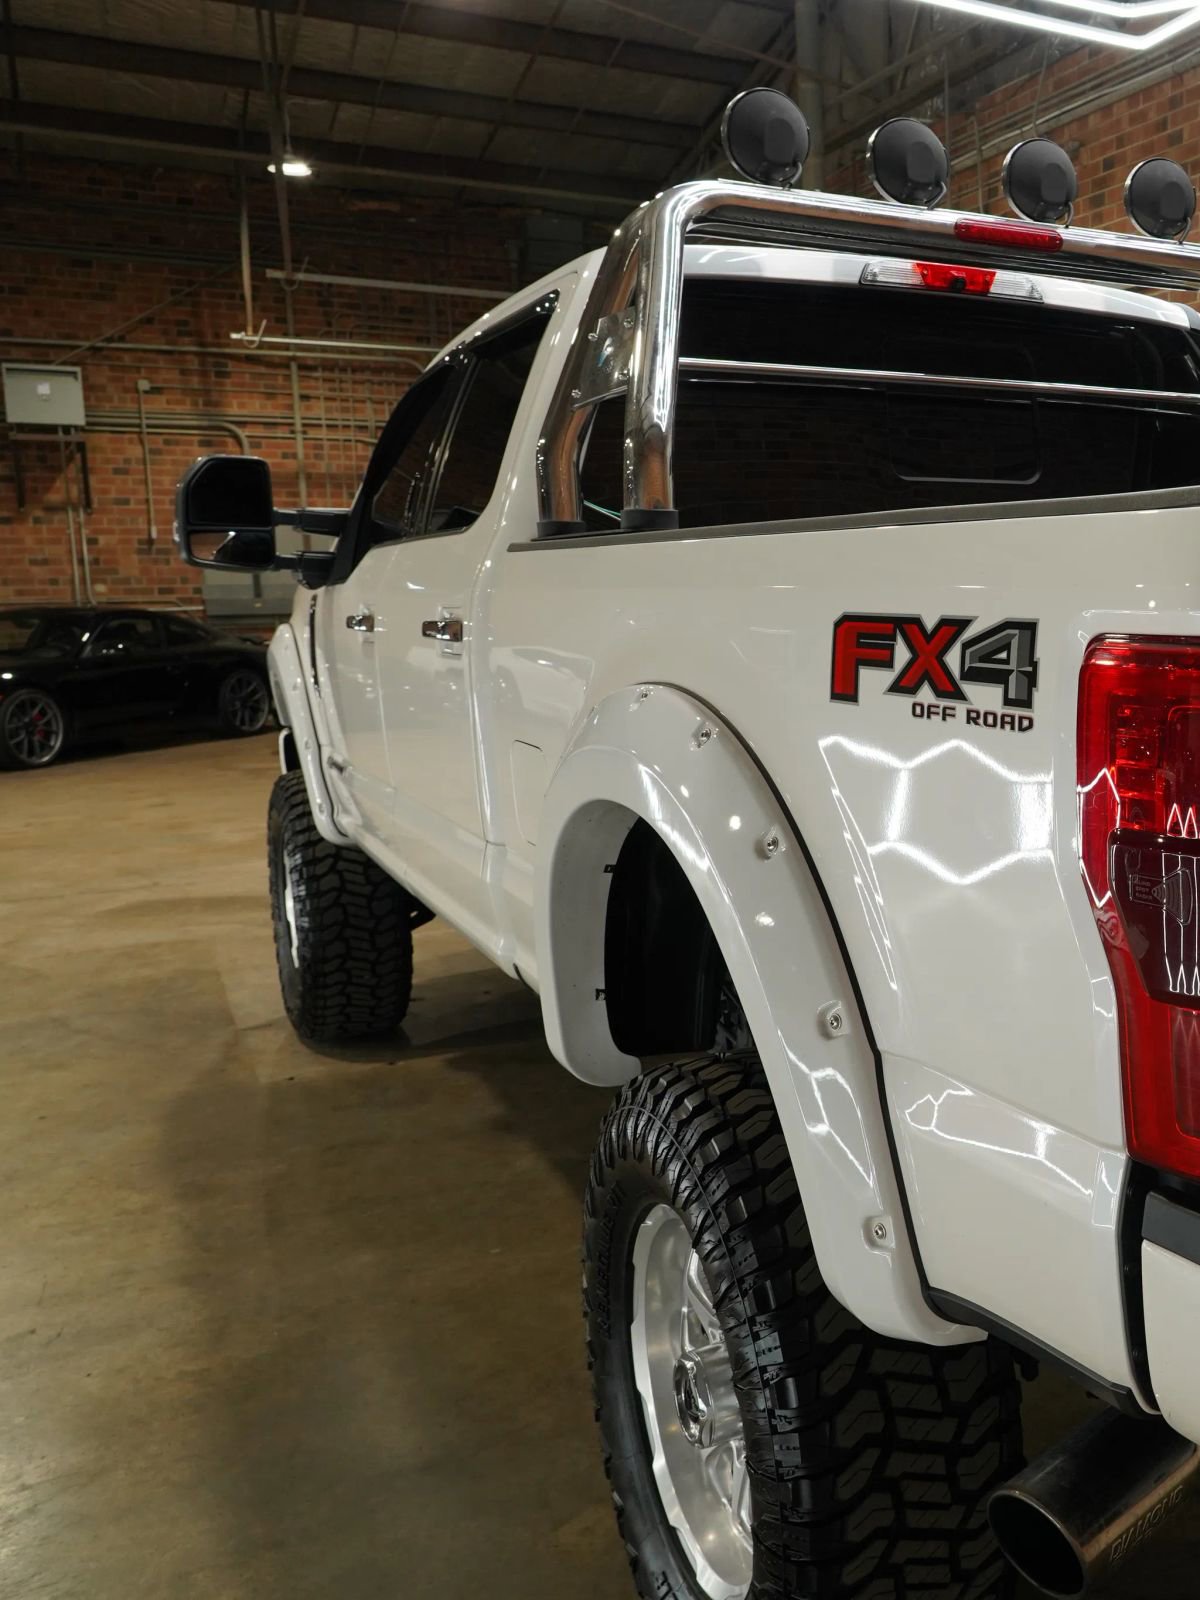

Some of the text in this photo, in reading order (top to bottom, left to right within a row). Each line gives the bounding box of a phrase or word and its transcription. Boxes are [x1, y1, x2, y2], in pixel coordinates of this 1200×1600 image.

[829, 611, 1040, 713] FX4
[911, 701, 1035, 733] OFF ROAD
